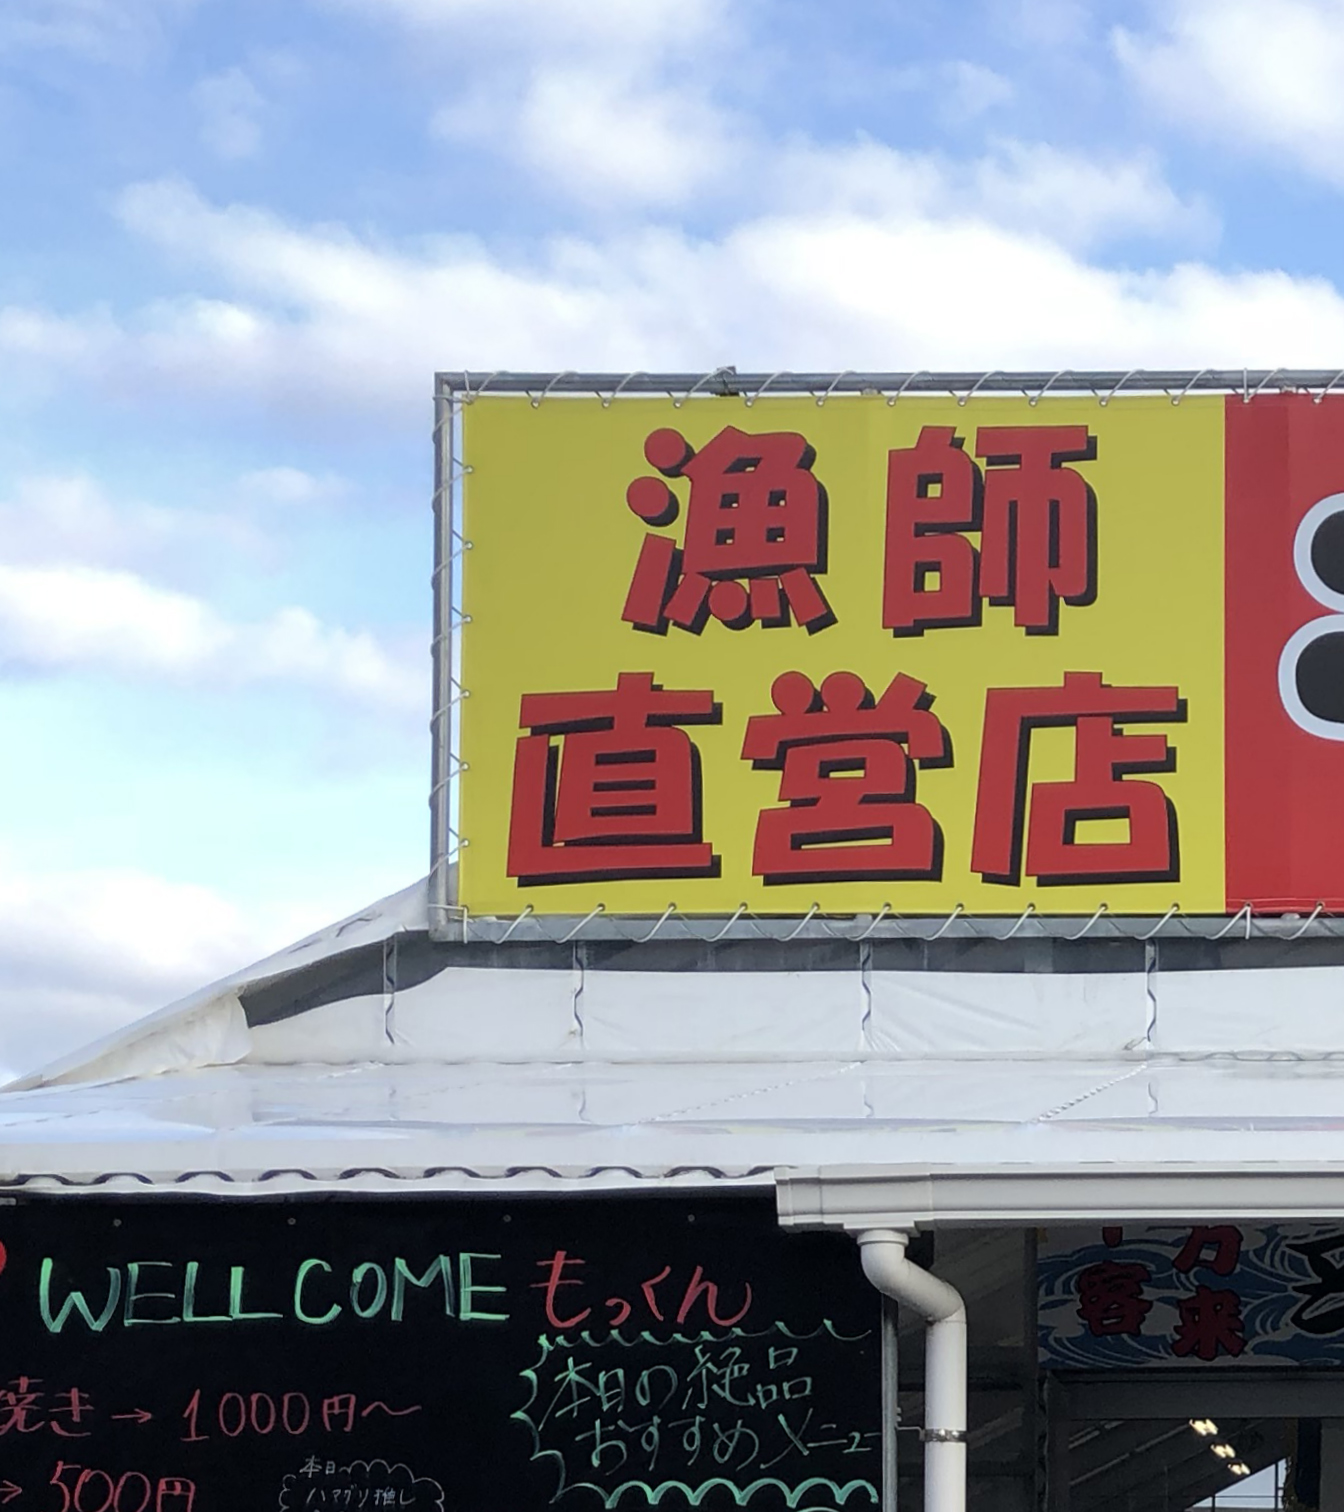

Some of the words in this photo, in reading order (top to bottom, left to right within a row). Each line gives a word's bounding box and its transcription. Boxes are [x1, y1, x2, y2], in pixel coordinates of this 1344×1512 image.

[625, 423, 1096, 638] 漁師
[508, 671, 1188, 886] 直営店
[38, 1253, 511, 1332] WELLCOME
[548, 1347, 816, 1425] 本日の絶品
